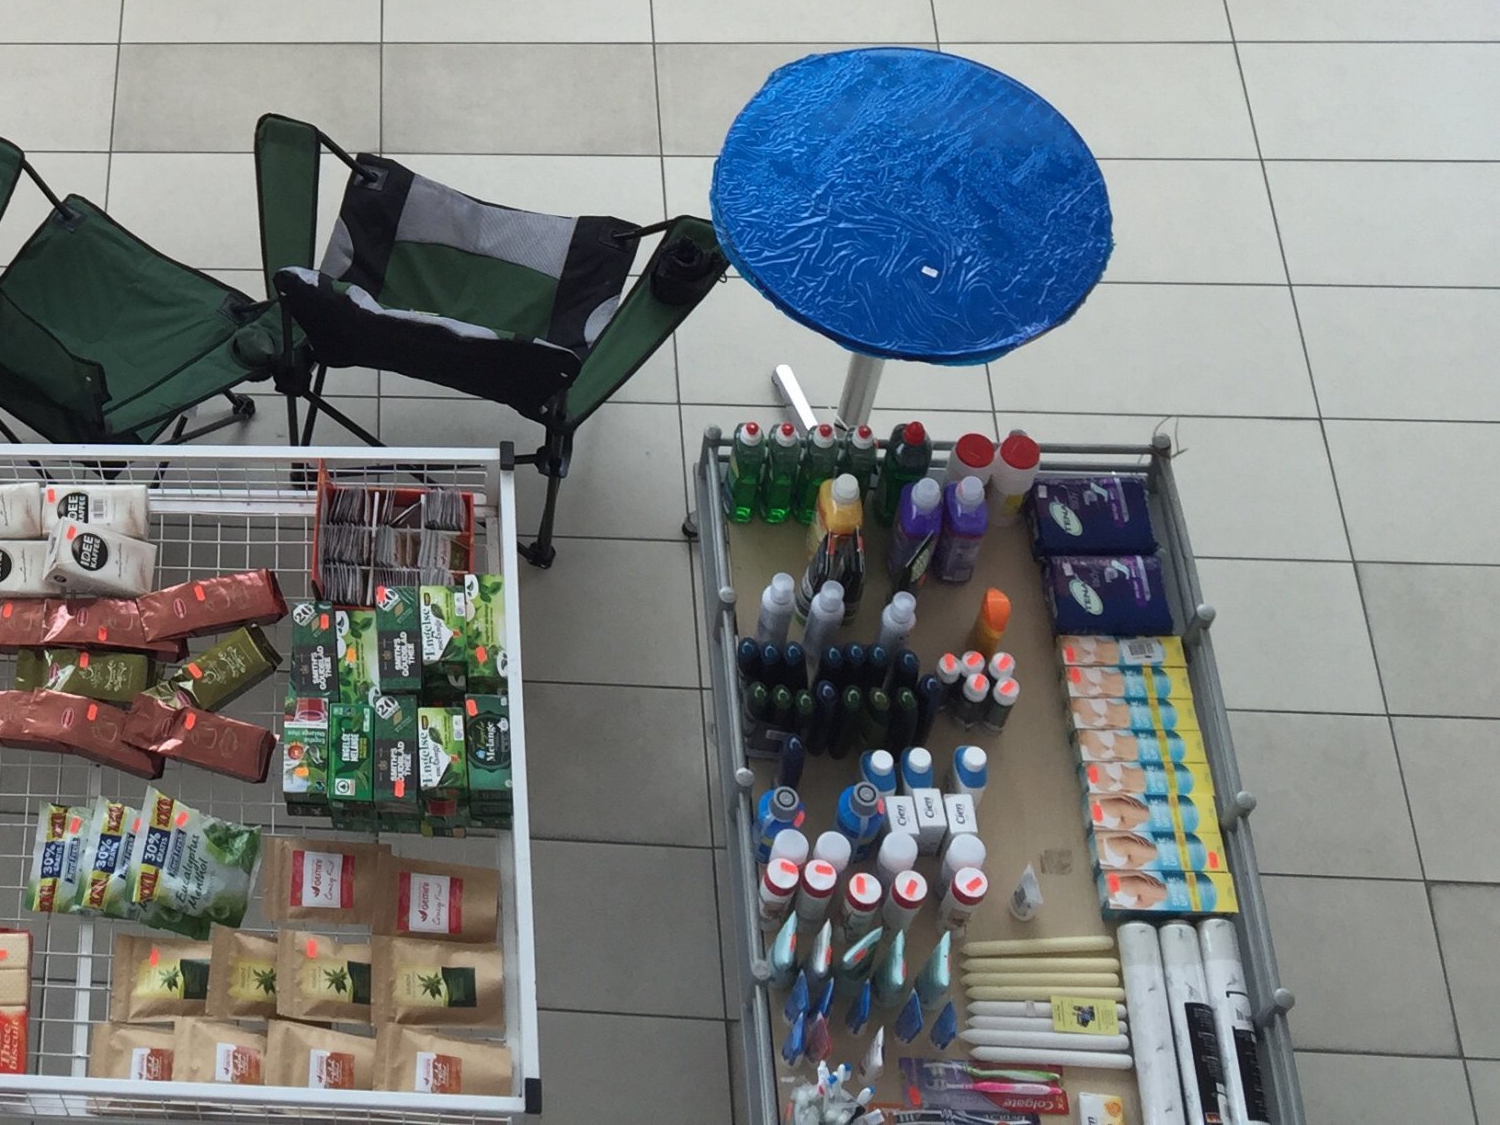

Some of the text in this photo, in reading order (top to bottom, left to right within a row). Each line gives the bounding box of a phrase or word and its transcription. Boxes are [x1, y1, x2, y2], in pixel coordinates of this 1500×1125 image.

[68, 494, 79, 521] DEE
[1060, 503, 1073, 534] TENA
[80, 534, 94, 567] IDEE
[89, 537, 101, 570] KAFFEE
[1081, 583, 1093, 613] TENA
[294, 605, 314, 623] 20
[407, 643, 416, 664] THEE
[376, 697, 398, 717] 20
[341, 731, 350, 762] ENGELSE
[348, 732, 360, 763] MELANGE
[486, 721, 496, 762] Melange
[403, 753, 412, 777] THEE
[156, 798, 174, 827] XXL
[896, 804, 907, 826] Cien
[924, 797, 935, 819] Cien
[956, 803, 966, 825] Cien
[42, 845, 56, 875] 30%
[52, 843, 64, 872] GRATIS
[95, 838, 112, 869] 30%
[143, 831, 162, 861] 30%
[155, 837, 169, 863] GRATIS
[176, 834, 201, 904] Eucalyptus
[188, 856, 208, 910] Menthol
[314, 858, 323, 886] Gemini
[139, 871, 159, 902] XXL
[423, 881, 431, 911] Gemini
[0, 1021, 12, 1068] Thee
[9, 1019, 20, 1071] biscuit
[1002, 1097, 1055, 1110] Colgate
